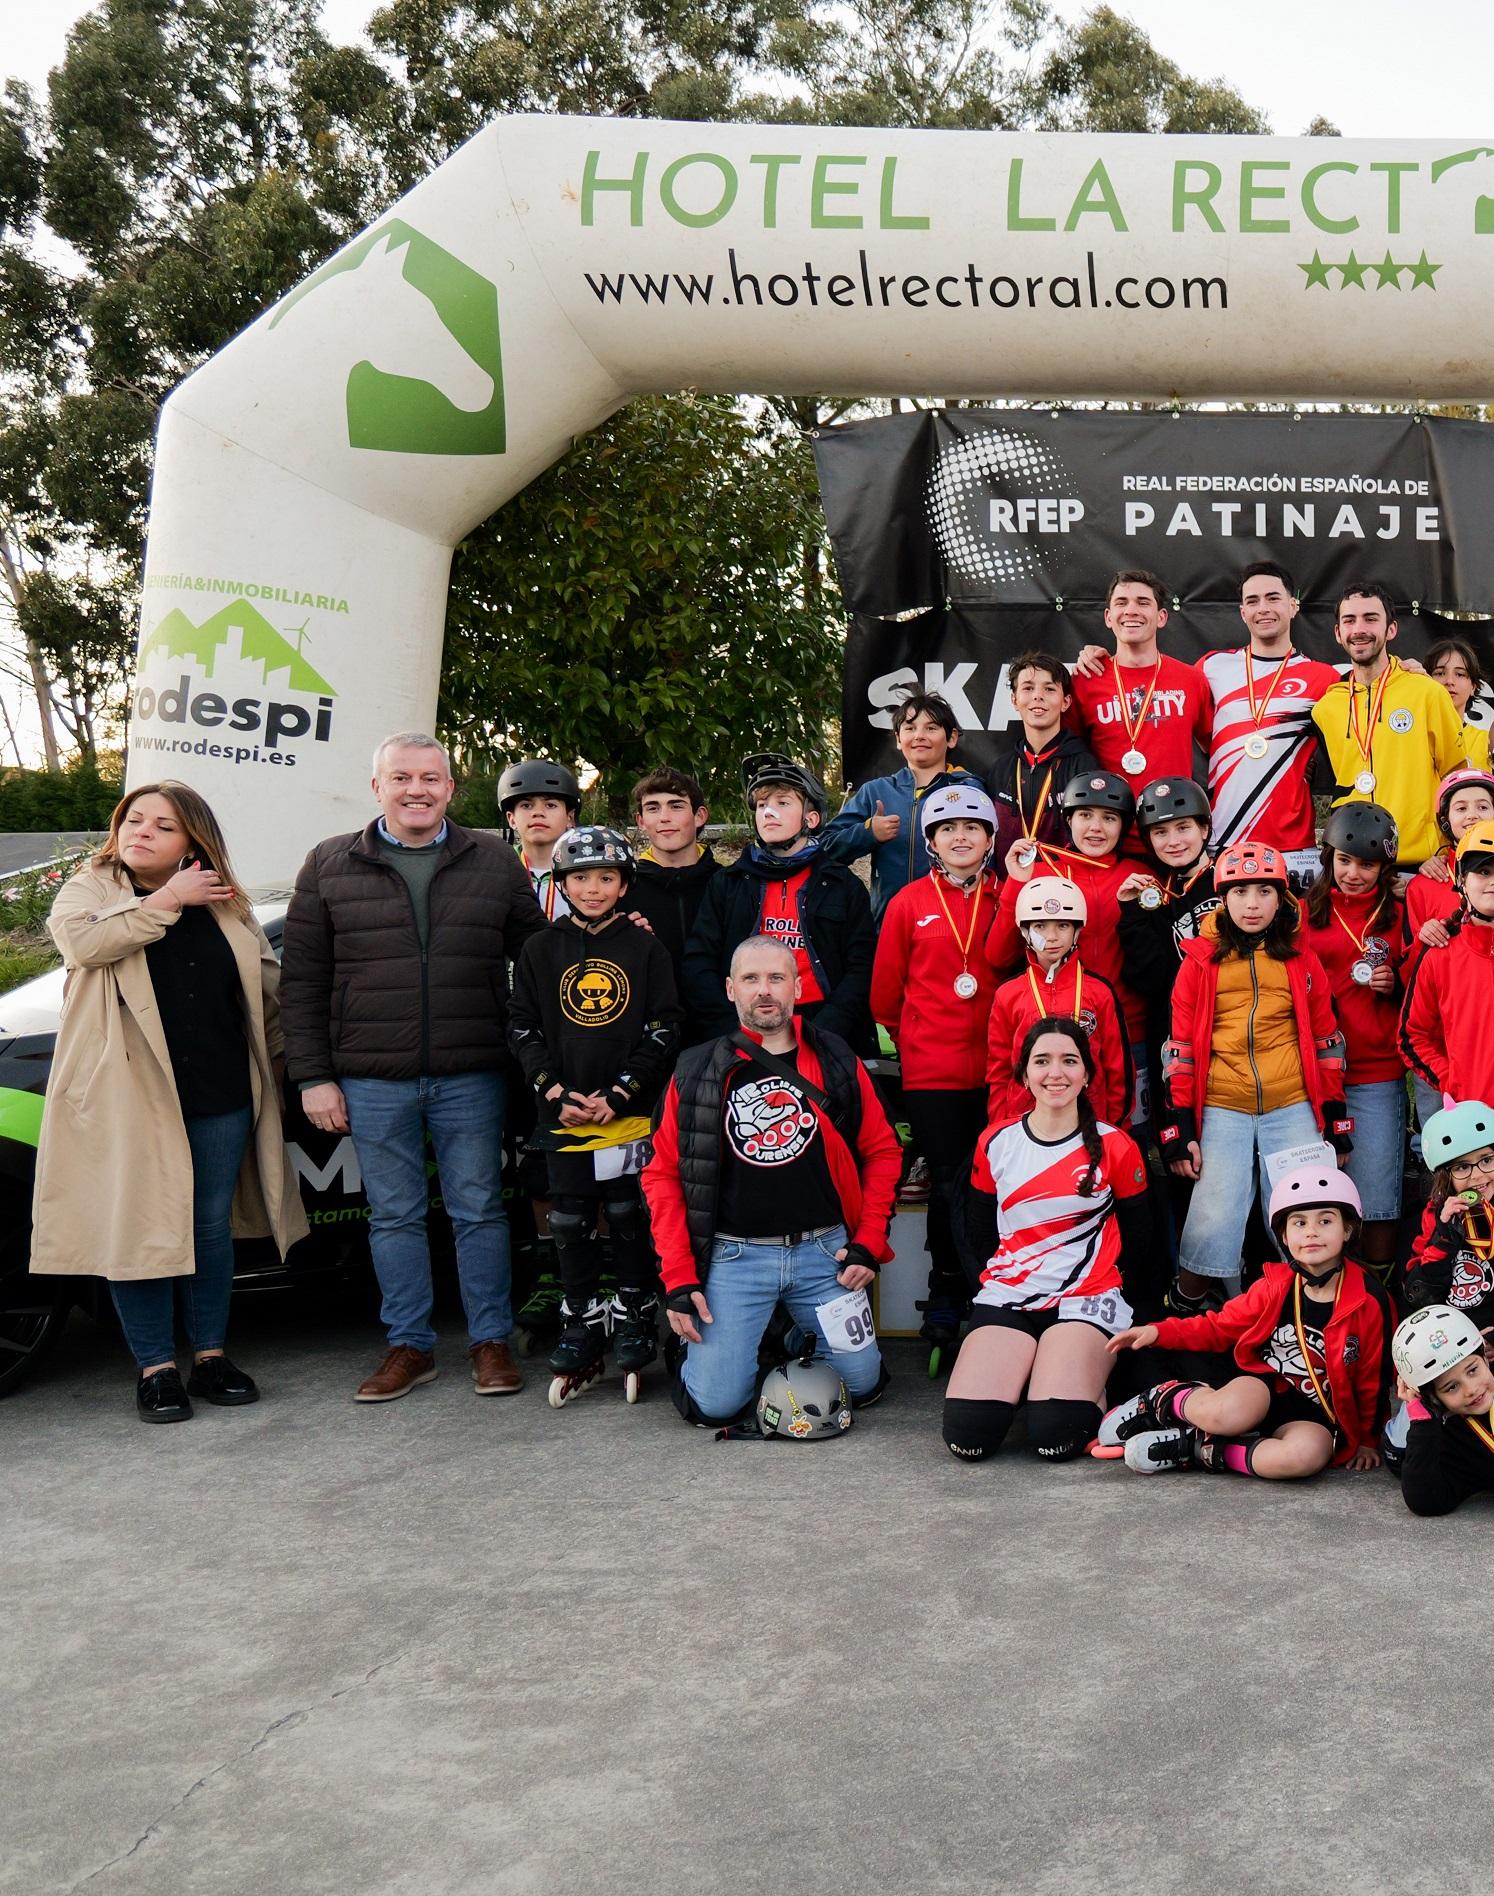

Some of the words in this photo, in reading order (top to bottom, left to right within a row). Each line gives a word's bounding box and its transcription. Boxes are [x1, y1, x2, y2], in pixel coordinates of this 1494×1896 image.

[580, 150, 931, 231] HOTEL
[1006, 157, 1129, 232] LA
[584, 248, 1229, 310] www.hotelrectoral.com
[1122, 475, 1172, 492] REAL
[1175, 473, 1297, 493] FEDERACIÓN
[1300, 473, 1401, 495] ESPAÑOLA
[1404, 479, 1429, 496] DE
[989, 499, 1085, 533] RFEP
[1124, 502, 1441, 541] PATINAJE
[134, 736, 297, 766] www.rodespi.es
[575, 1013, 609, 1022] VALLADOLID
[618, 1141, 651, 1170] 78
[845, 1307, 874, 1346] 99
[1081, 1296, 1117, 1325] 83
